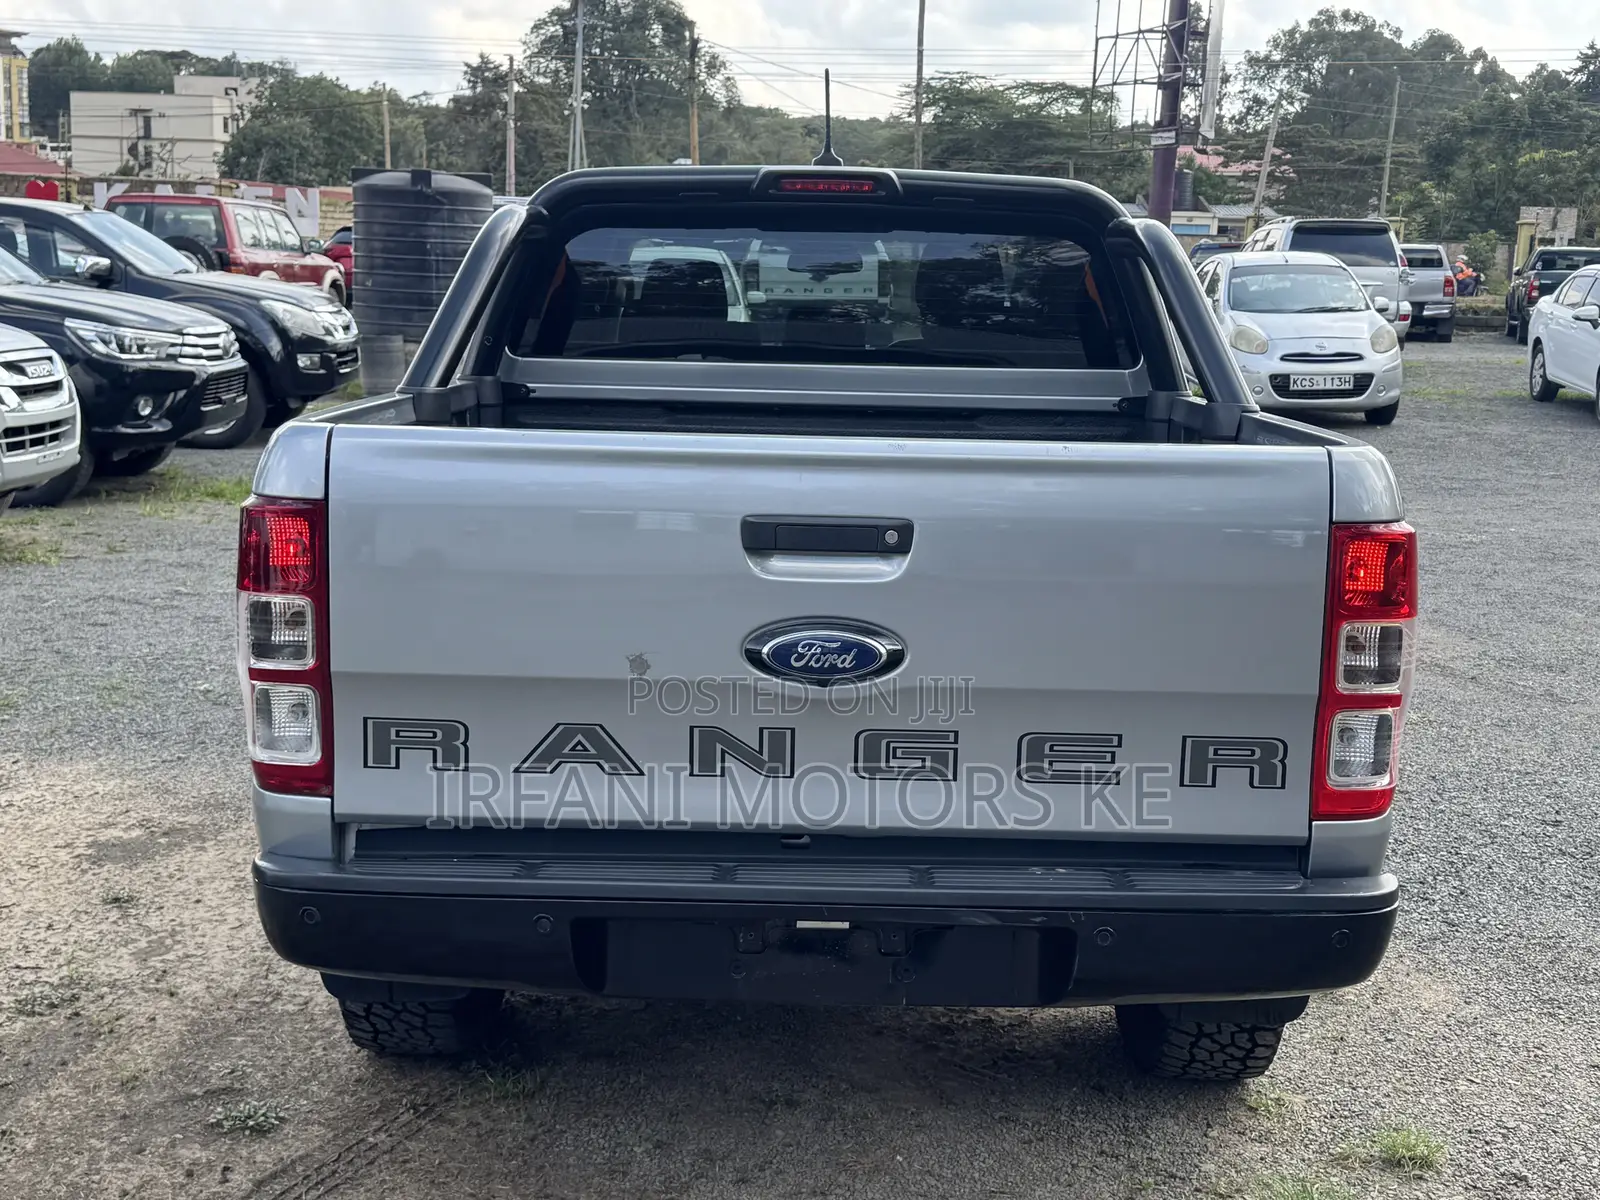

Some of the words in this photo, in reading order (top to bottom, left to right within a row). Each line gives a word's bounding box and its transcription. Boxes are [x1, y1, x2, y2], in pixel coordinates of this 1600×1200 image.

[27, 364, 52, 378] ISUZ
[1292, 377, 1315, 388] KCS
[1323, 376, 1351, 387] 113H
[790, 639, 857, 669] Ford
[362, 716, 1289, 790] RANGER
